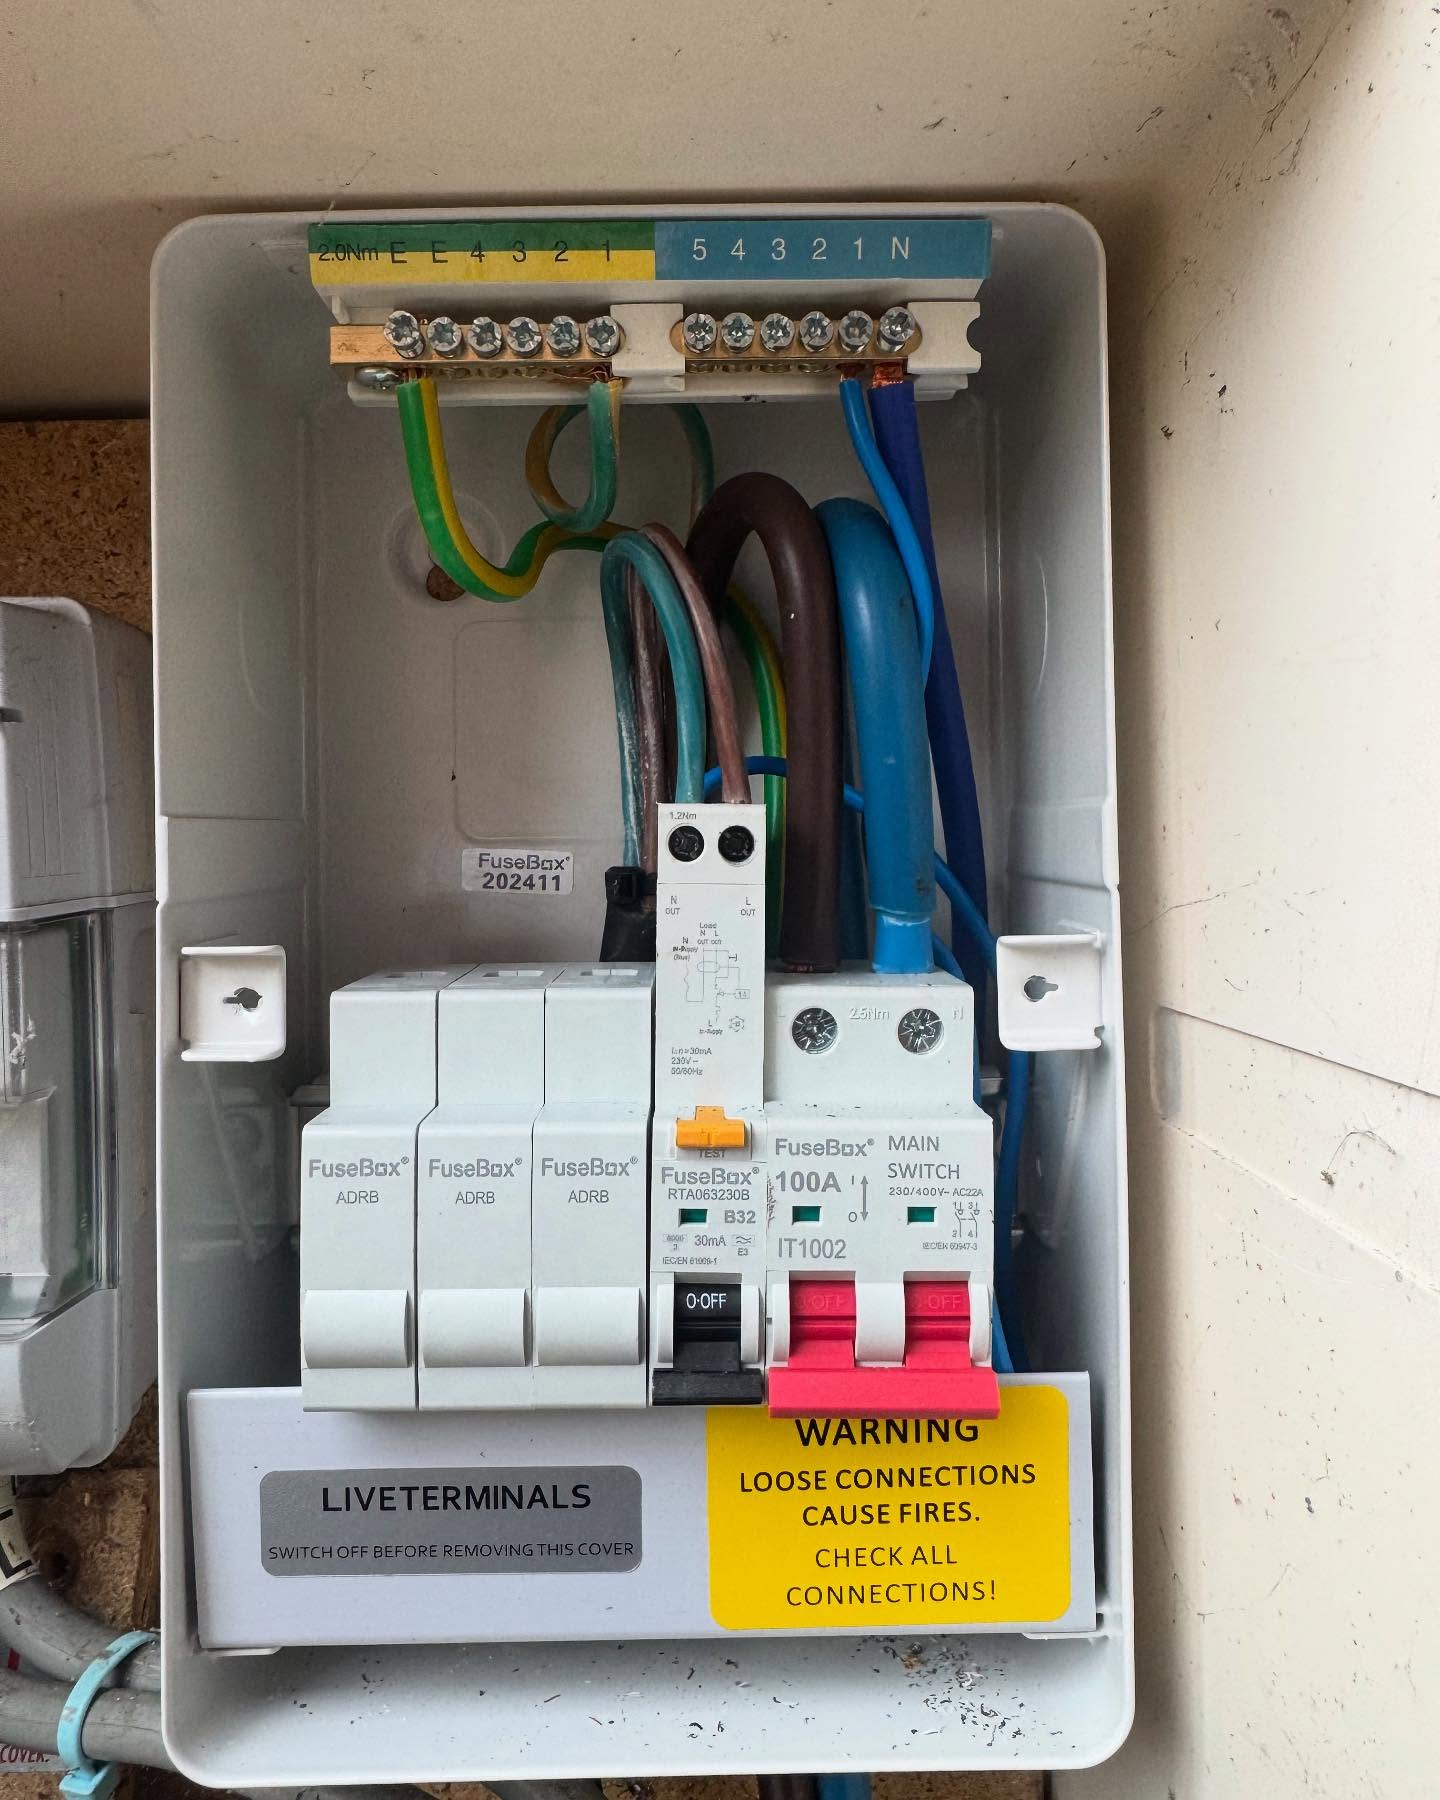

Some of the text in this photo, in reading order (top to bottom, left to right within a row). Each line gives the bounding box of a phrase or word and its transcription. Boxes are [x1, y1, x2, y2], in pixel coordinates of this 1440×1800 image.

[318, 239, 610, 264] 2.0Nm E E 4 3 2 1
[692, 236, 910, 261] 5 4 3 2 1 N
[482, 872, 561, 891] 202411
[670, 895, 678, 905] N
[745, 896, 751, 906] L
[665, 907, 680, 915] OUT
[740, 908, 756, 917] OUT
[888, 1135, 940, 1152] MAIN
[698, 1148, 727, 1159] TEST
[887, 1162, 960, 1180] SWITCH
[775, 1171, 842, 1193] 100A
[336, 1190, 380, 1205] ADRB
[455, 1190, 496, 1205] ADRB
[568, 1189, 610, 1204] ADRB
[668, 1188, 750, 1201] RTA063230B
[724, 1209, 756, 1224] B32
[694, 1234, 727, 1247] 30mA
[778, 1237, 847, 1259] IT1002
[927, 1294, 962, 1310] OFF
[795, 1418, 979, 1447] WARNING
[740, 1463, 1036, 1493] LOOSE CONNECTIONS
[801, 1501, 981, 1527] CAUSE FIRES.
[269, 1541, 634, 1560] SWITCH OFF BEFORE REMOVING THIS COVER
[815, 1544, 958, 1569] CHECK ALL
[786, 1579, 997, 1607] CONNECTIONS!
